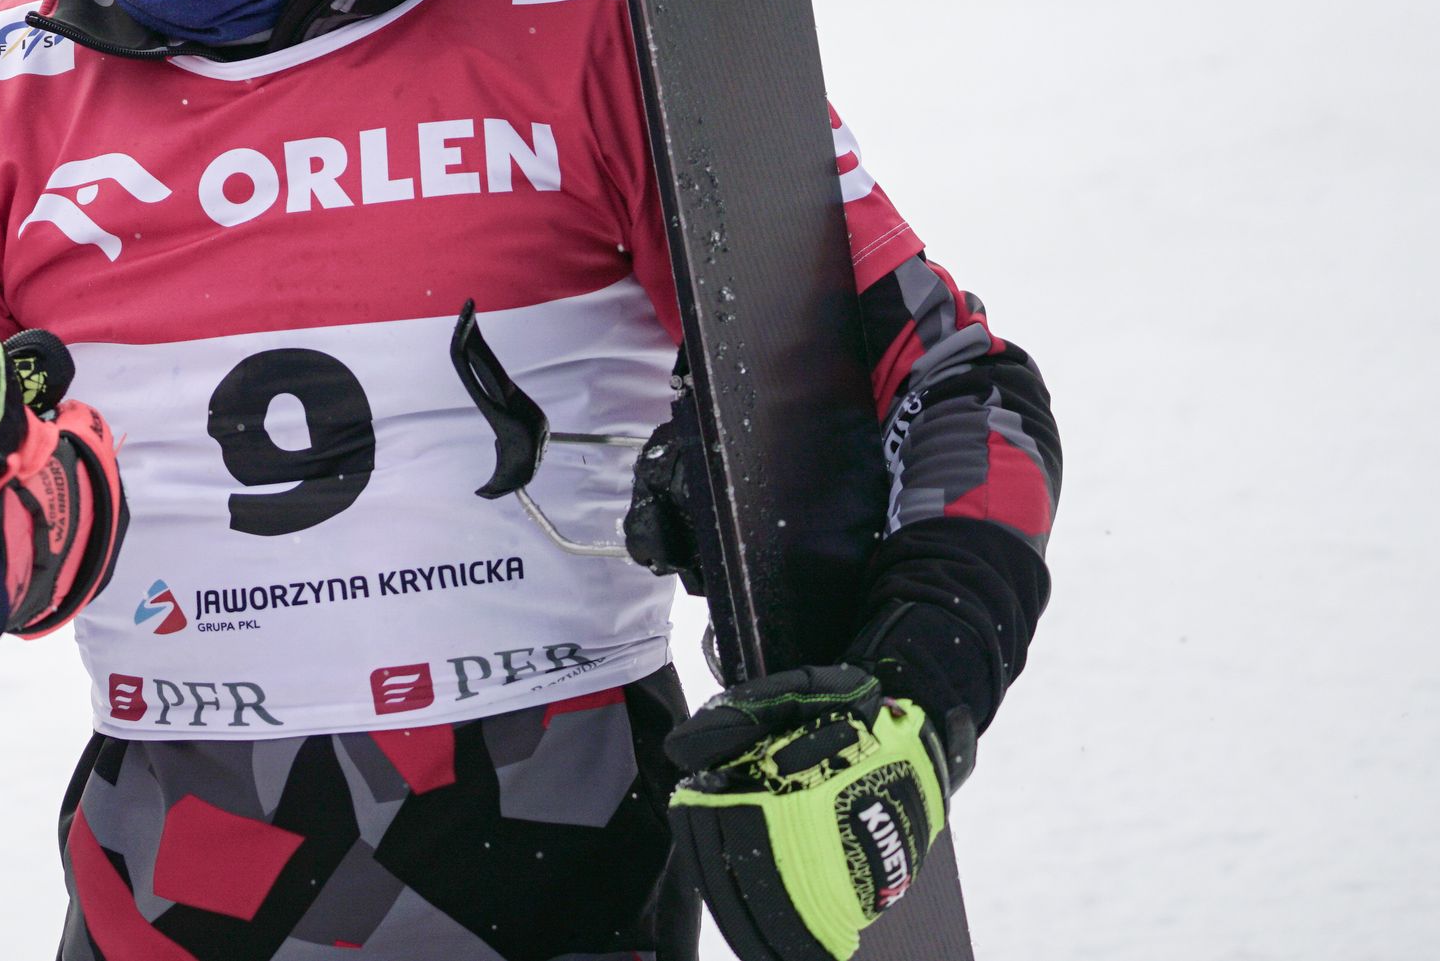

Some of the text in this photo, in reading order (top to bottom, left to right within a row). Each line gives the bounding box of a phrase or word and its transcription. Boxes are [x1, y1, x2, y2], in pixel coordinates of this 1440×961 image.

[198, 118, 561, 227] ORLEN
[207, 347, 376, 536] 9
[196, 556, 525, 620] JAWORZYNA KRYNICKA
[197, 620, 261, 633] GRUPA PKL
[152, 678, 284, 728] PFR
[447, 642, 606, 702] PFR
